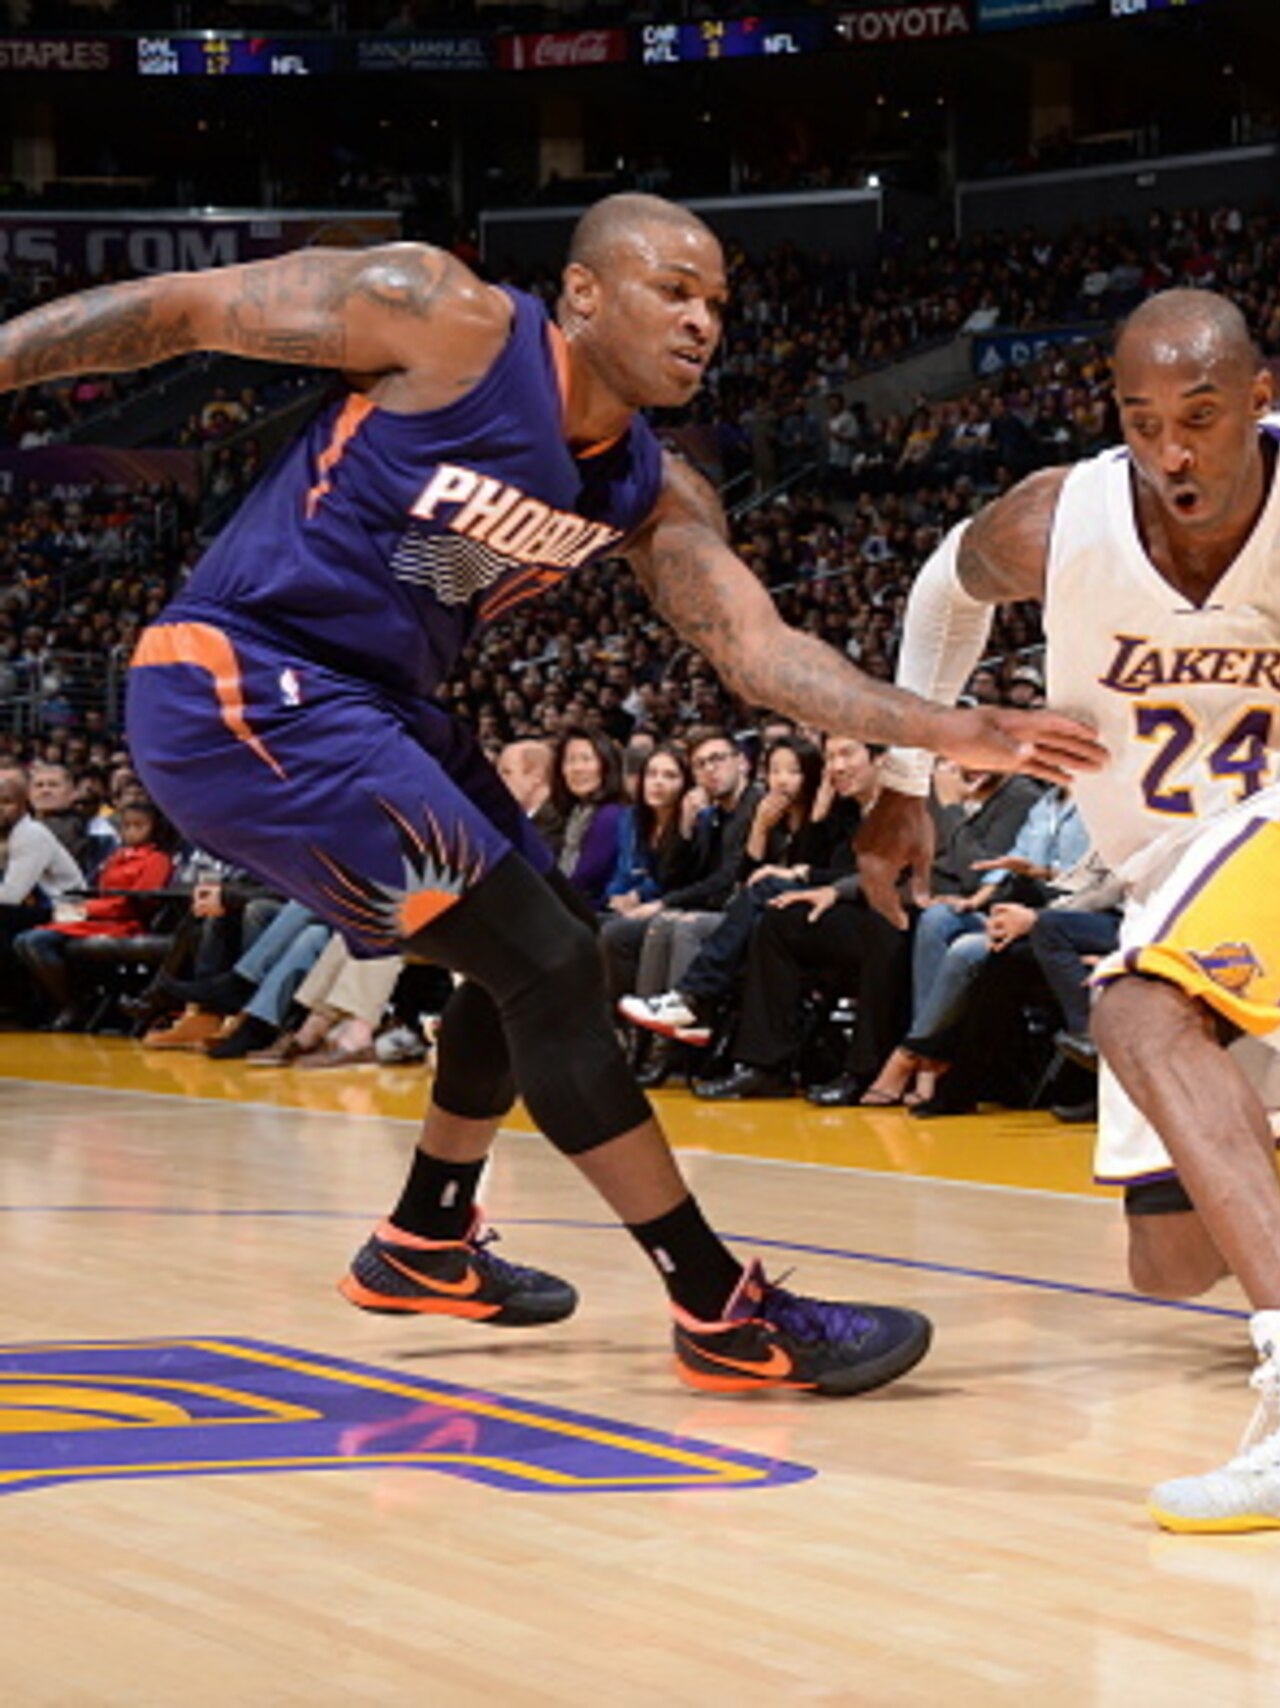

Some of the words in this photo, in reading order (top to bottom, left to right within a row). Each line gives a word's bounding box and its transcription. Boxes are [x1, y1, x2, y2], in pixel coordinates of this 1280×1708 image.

[842, 8, 970, 41] TOYOTA
[762, 33, 799, 54] NFL
[271, 55, 310, 75] NFL
